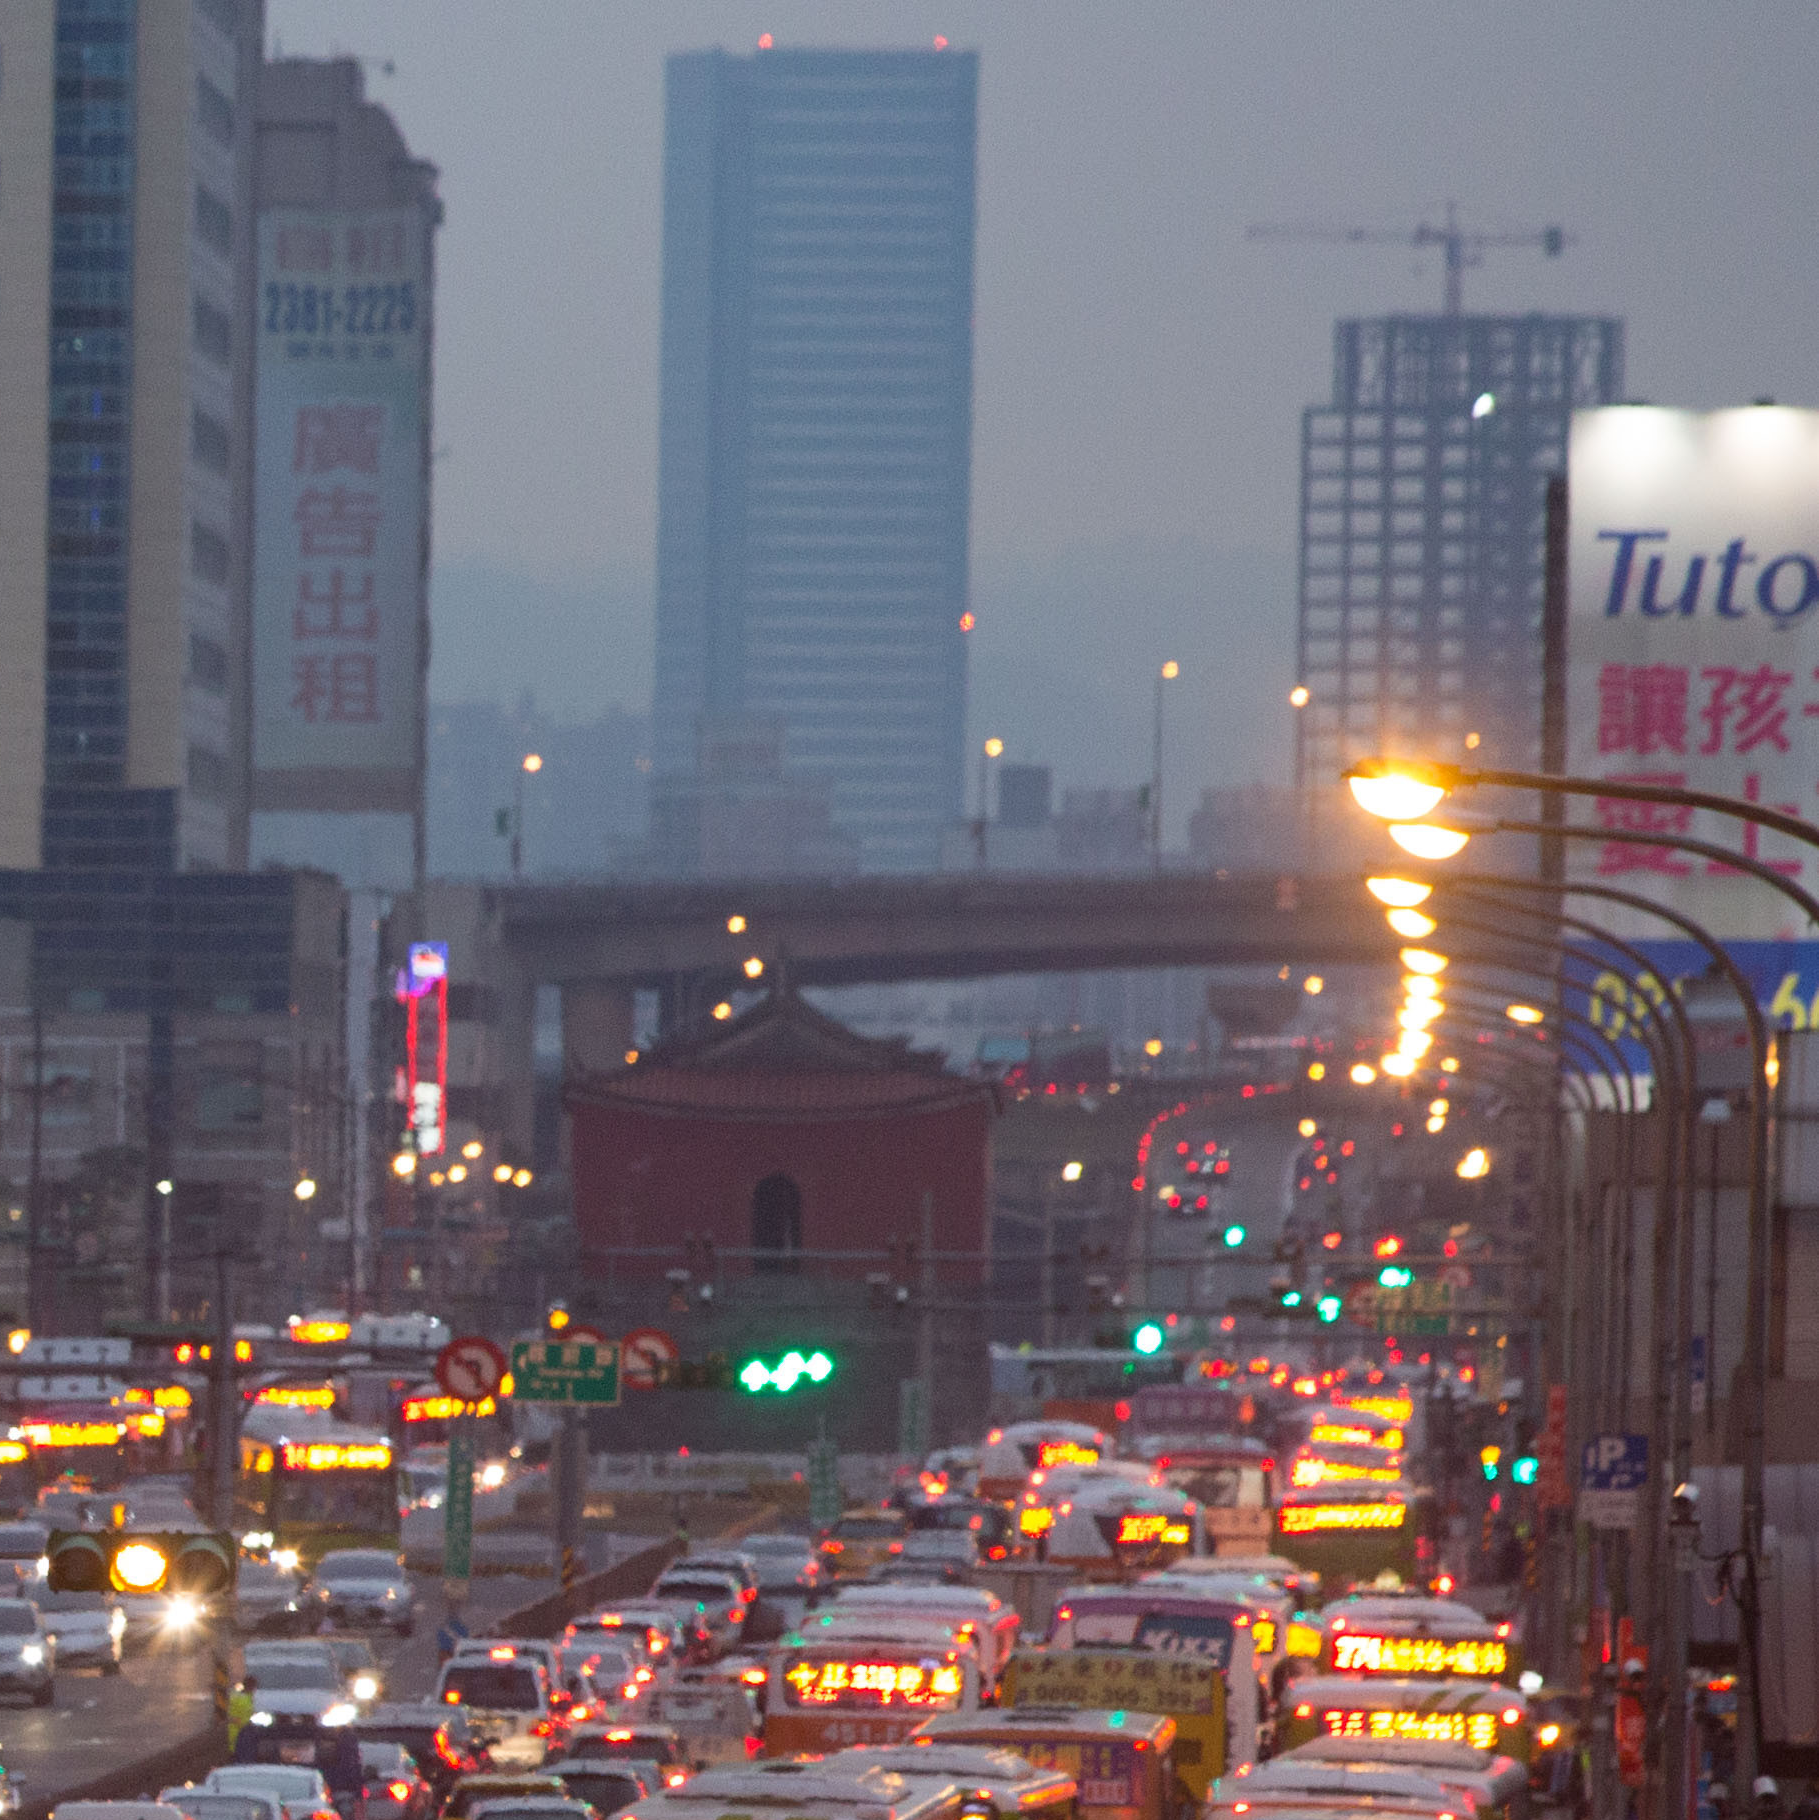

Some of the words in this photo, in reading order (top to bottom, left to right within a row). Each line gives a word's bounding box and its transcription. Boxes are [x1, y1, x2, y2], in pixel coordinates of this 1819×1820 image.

[293, 401, 385, 726] 廣告出租
[1597, 661, 1819, 757] 讓孩
